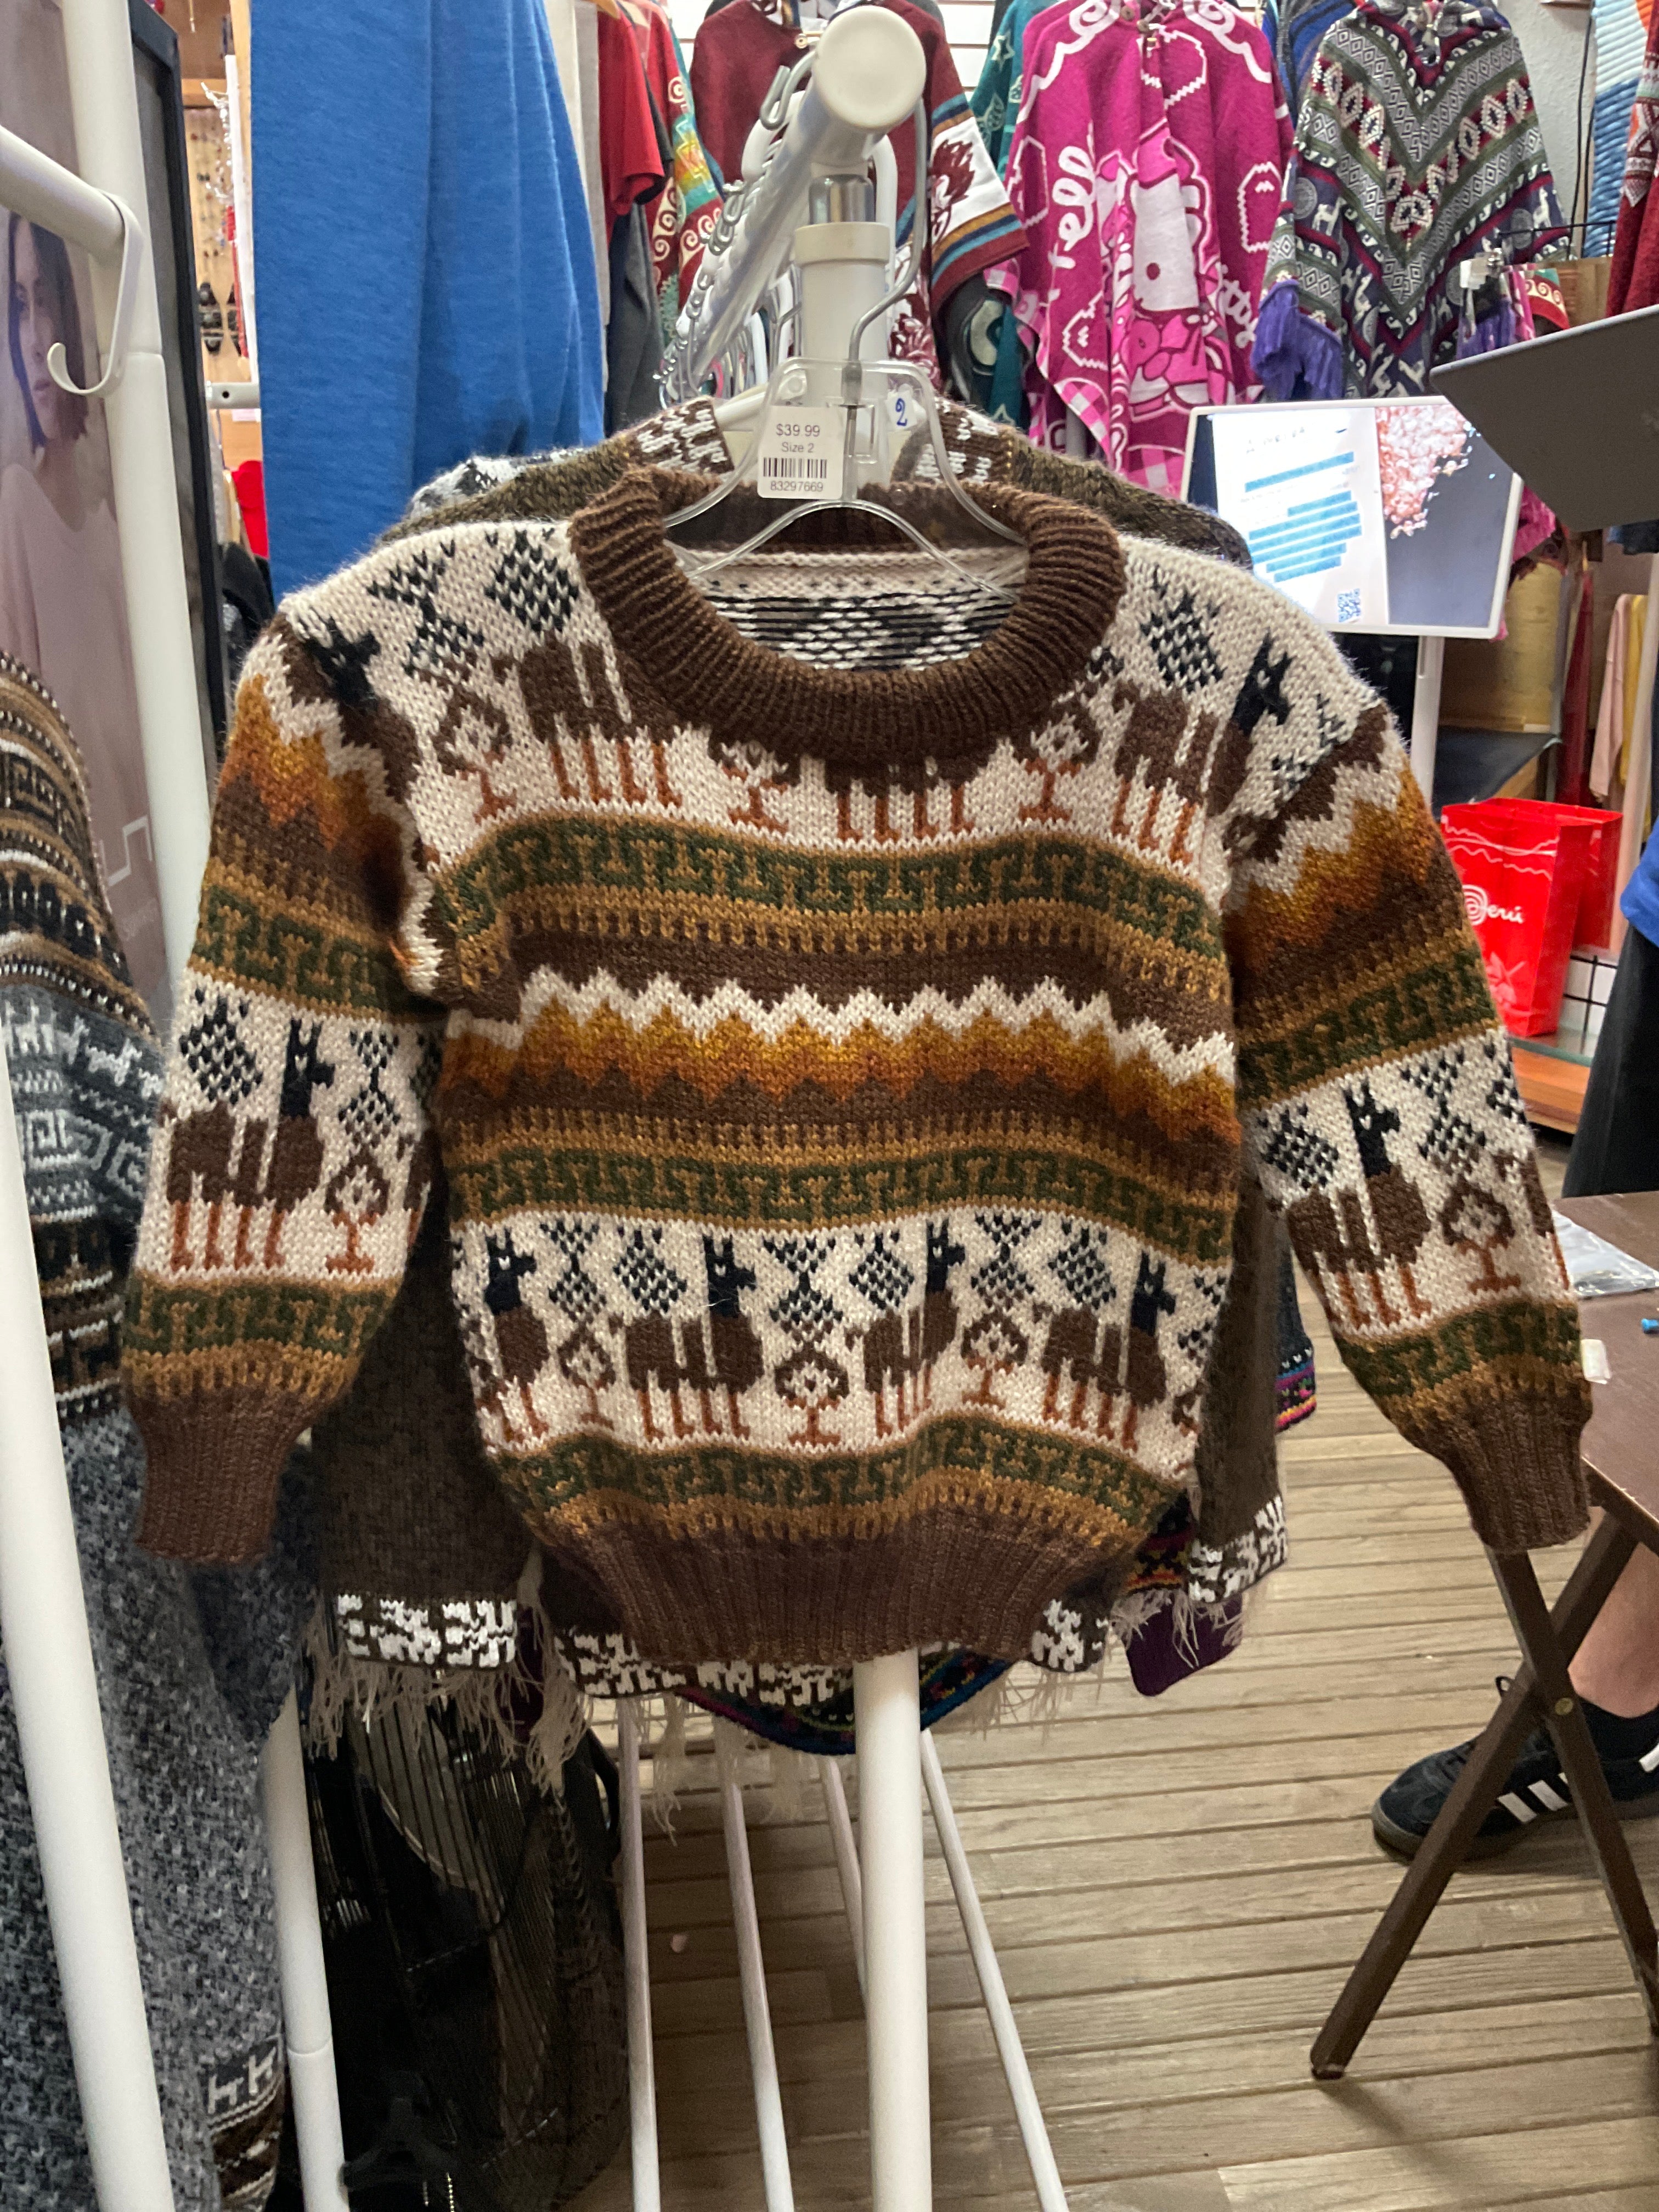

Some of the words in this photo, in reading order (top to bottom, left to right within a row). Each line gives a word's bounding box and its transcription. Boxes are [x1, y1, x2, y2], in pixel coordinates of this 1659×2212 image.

[895, 398, 907, 426] 2
[776, 423, 820, 437] $39.99
[781, 442, 804, 453] Size
[808, 443, 815, 453] 2
[770, 481, 823, 492] 83297669
